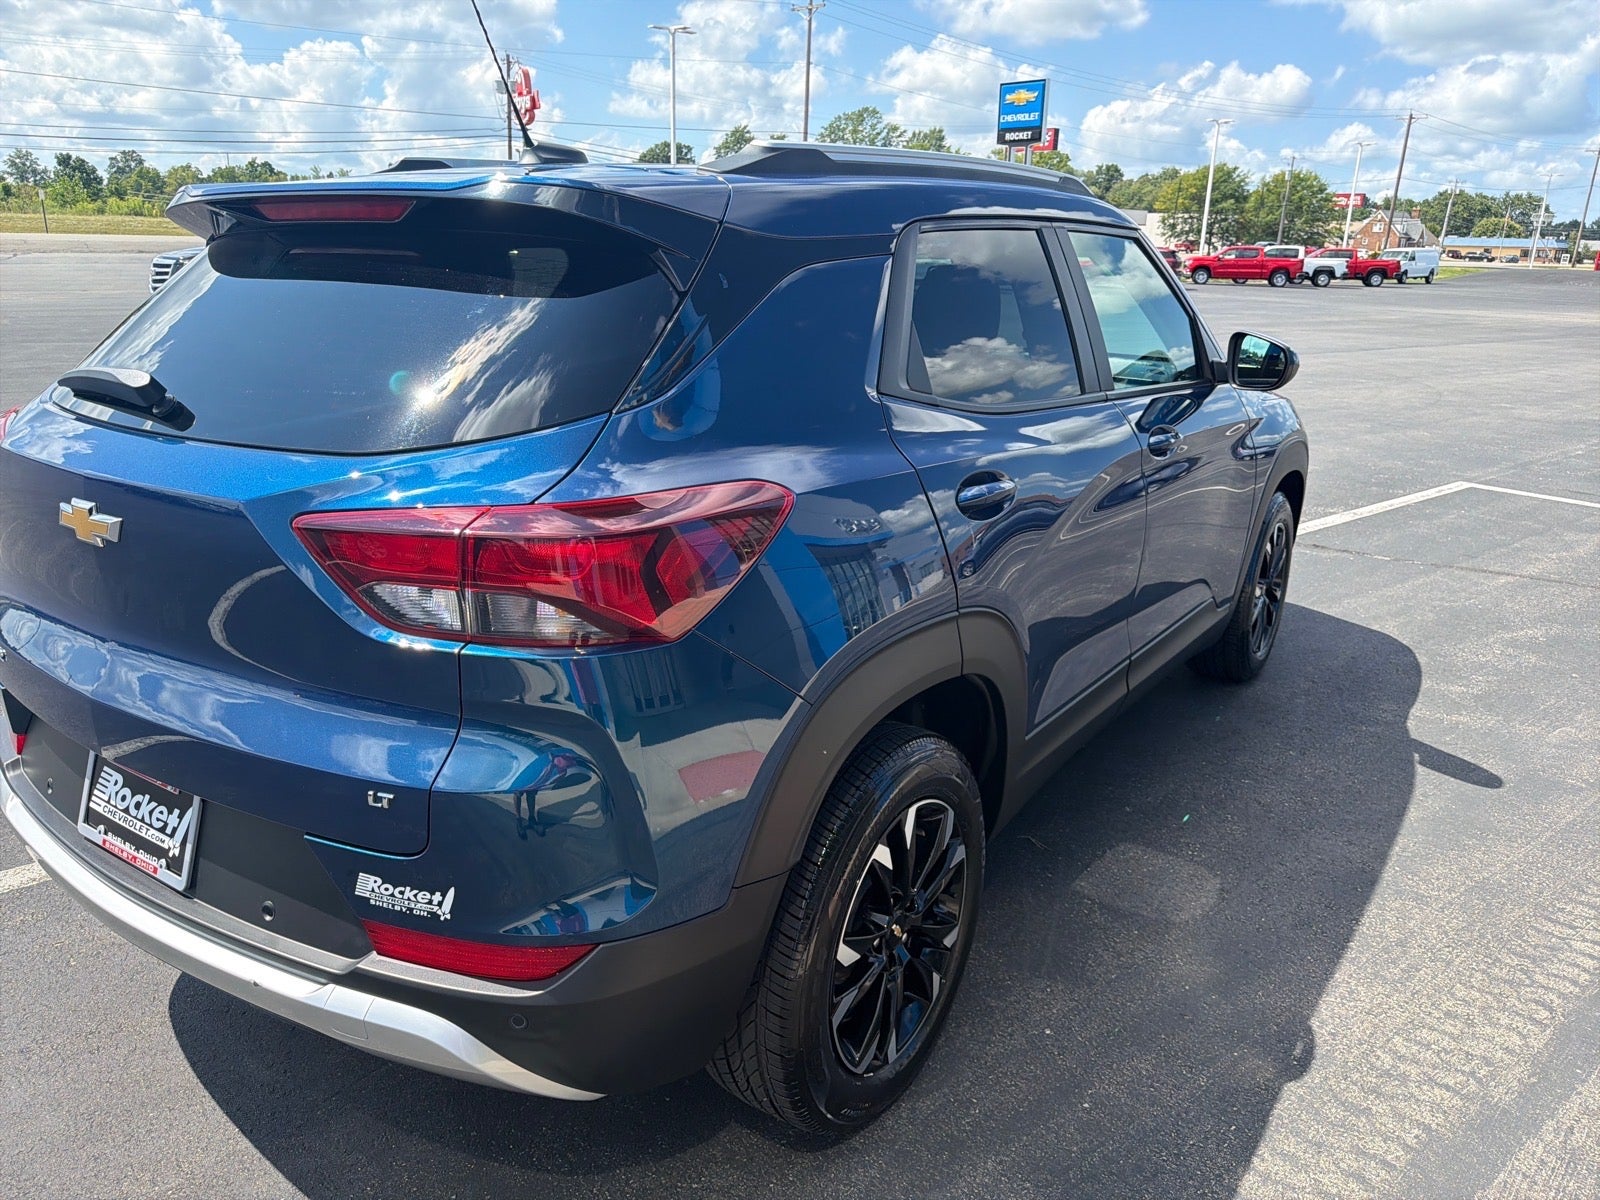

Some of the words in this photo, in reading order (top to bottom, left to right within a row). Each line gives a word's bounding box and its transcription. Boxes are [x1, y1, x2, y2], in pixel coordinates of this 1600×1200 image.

[1000, 112, 1040, 122] CHEVROLET
[1005, 131, 1033, 141] ROCKET
[99, 766, 181, 834] Rocket
[367, 790, 395, 809] LT
[102, 804, 166, 846] CHEVROLET.COM
[135, 858, 155, 872] OHIO
[362, 873, 443, 906] Rocket
